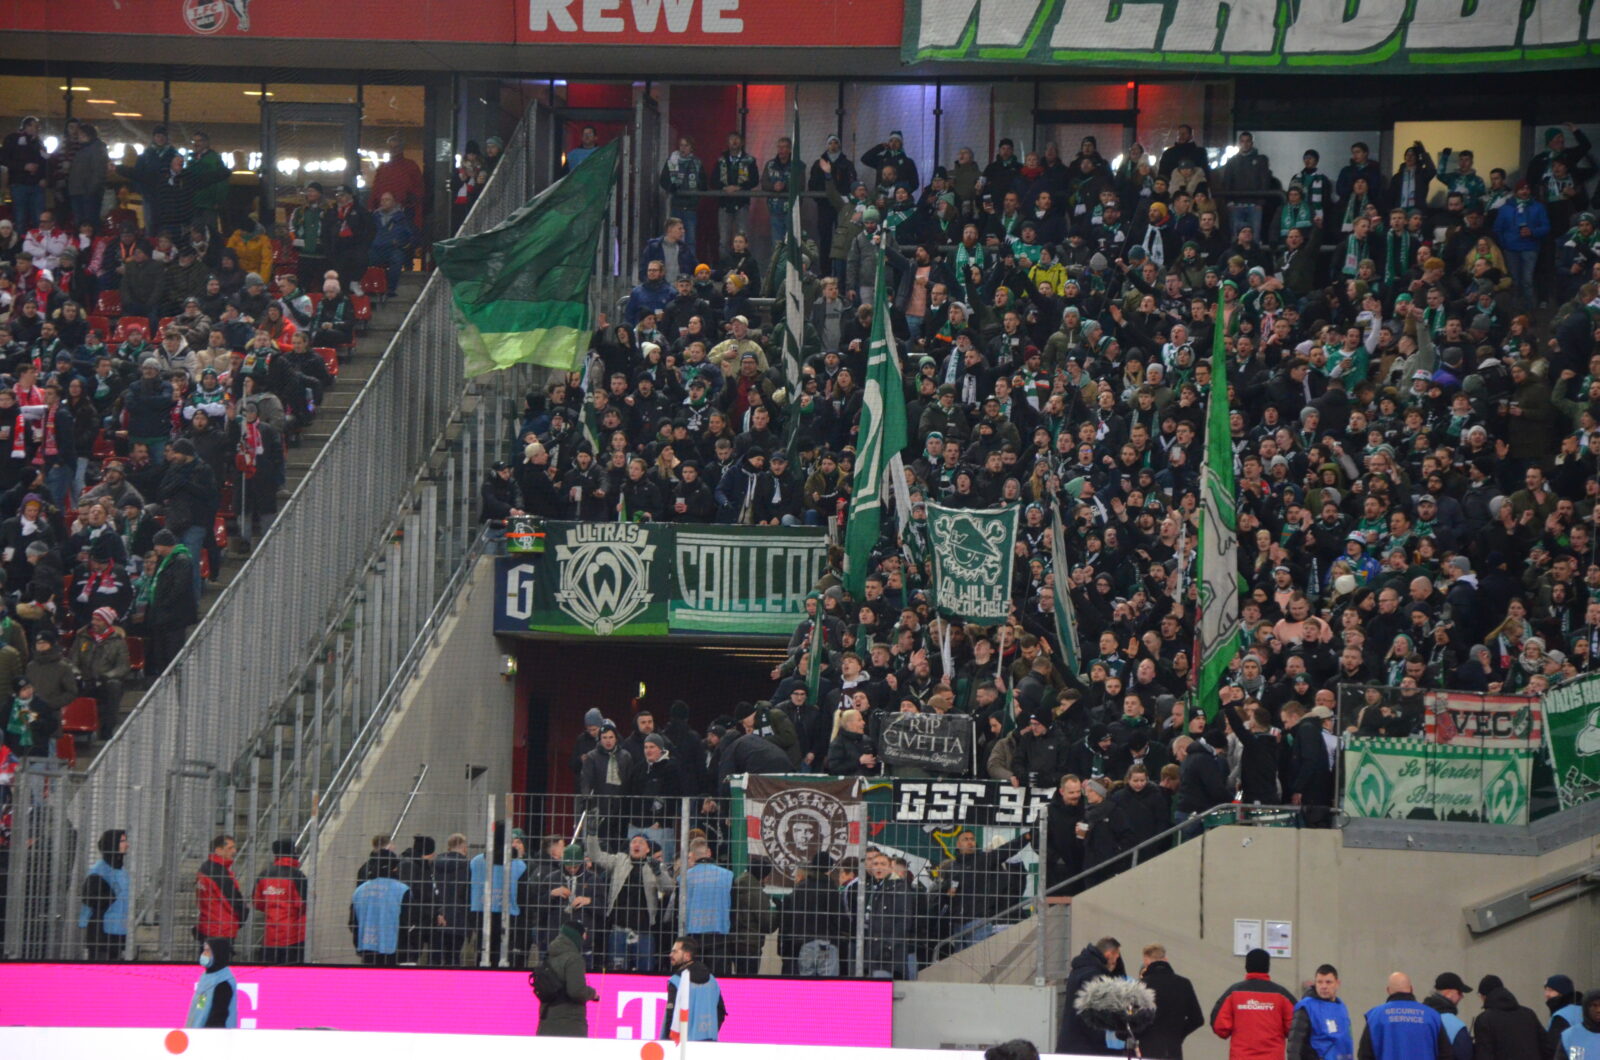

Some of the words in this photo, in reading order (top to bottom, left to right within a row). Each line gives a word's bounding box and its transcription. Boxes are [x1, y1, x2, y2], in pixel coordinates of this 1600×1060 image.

[529, 0, 744, 33] REWE
[575, 524, 640, 544] ULTRAS
[959, 584, 986, 601] WILL
[992, 584, 1003, 601] IS
[910, 719, 941, 734] RIP
[1451, 710, 1513, 738] VEC
[883, 729, 964, 754] CIVETTA
[1427, 759, 1481, 779] Werder
[896, 783, 986, 821] GSF
[1406, 784, 1472, 805] Bremen
[1385, 1007, 1425, 1016] SECURITY
[1388, 1015, 1424, 1024] SERVICE
